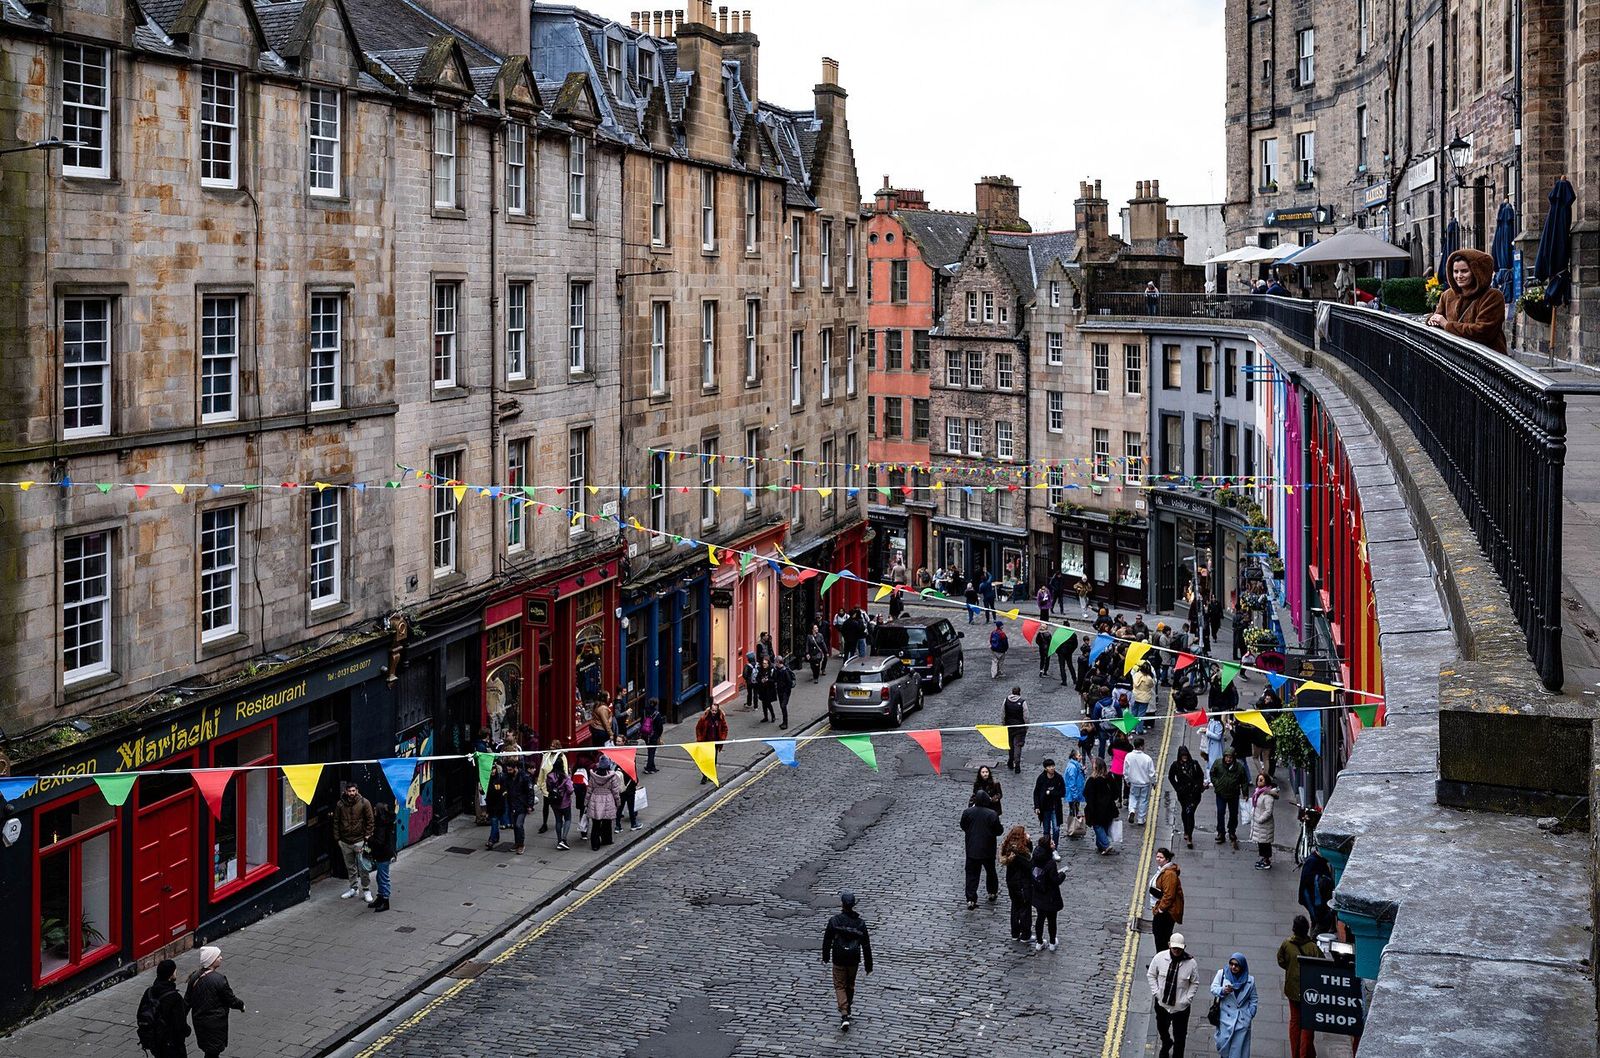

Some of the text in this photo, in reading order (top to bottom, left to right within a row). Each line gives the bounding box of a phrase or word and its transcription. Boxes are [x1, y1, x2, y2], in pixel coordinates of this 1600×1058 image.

[337, 667, 349, 678] 0131
[350, 663, 359, 674] 623
[359, 659, 371, 670] 0077
[22, 680, 307, 799] Mexican Mariachi Restaurant
[1320, 974, 1351, 987] THE
[1315, 1012, 1357, 1026] SHOP
